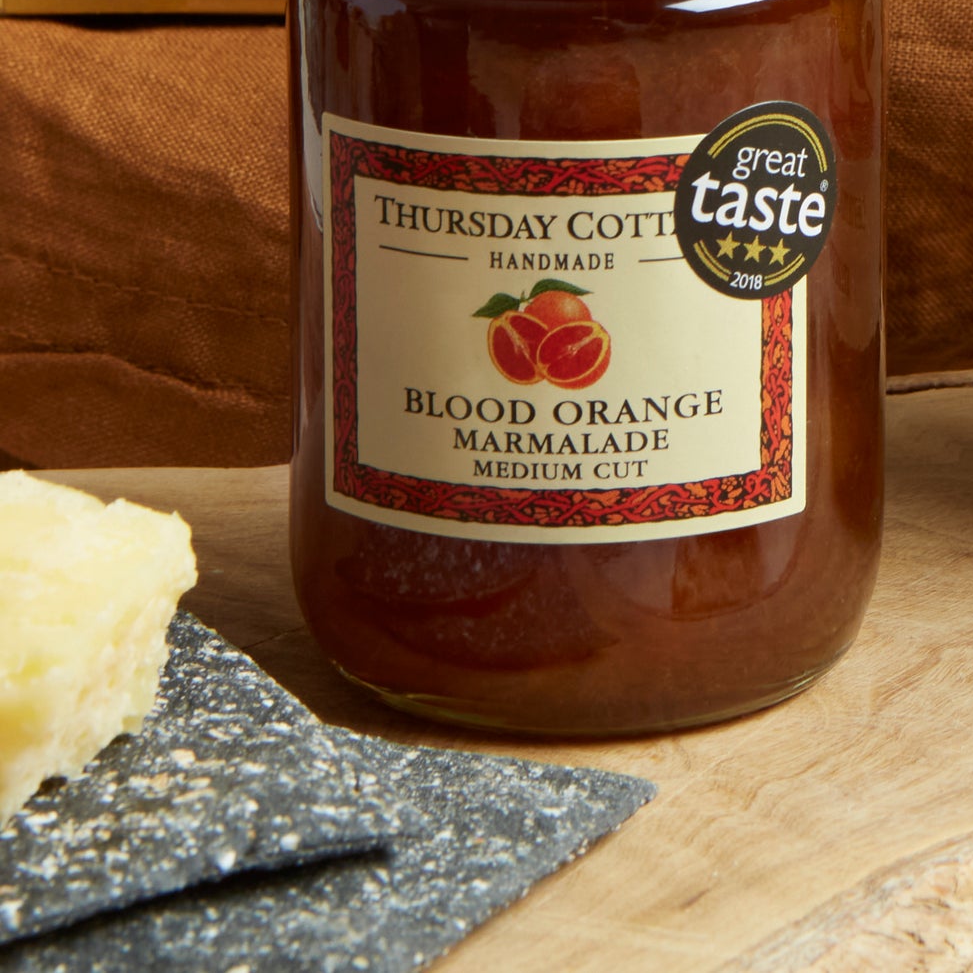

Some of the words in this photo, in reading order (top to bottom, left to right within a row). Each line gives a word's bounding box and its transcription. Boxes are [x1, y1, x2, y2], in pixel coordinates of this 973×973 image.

[732, 147, 808, 180] great
[375, 195, 556, 241] THURSDAY
[568, 210, 678, 241] COTT
[691, 171, 826, 237] taste
[489, 251, 615, 271] HANDMADE
[729, 271, 764, 291] 2018
[403, 387, 536, 425] BLOOD
[553, 389, 723, 426] ORANGE
[453, 427, 670, 455] MARMALADE
[473, 459, 583, 481] MEDIUM
[593, 459, 648, 480] CUT
